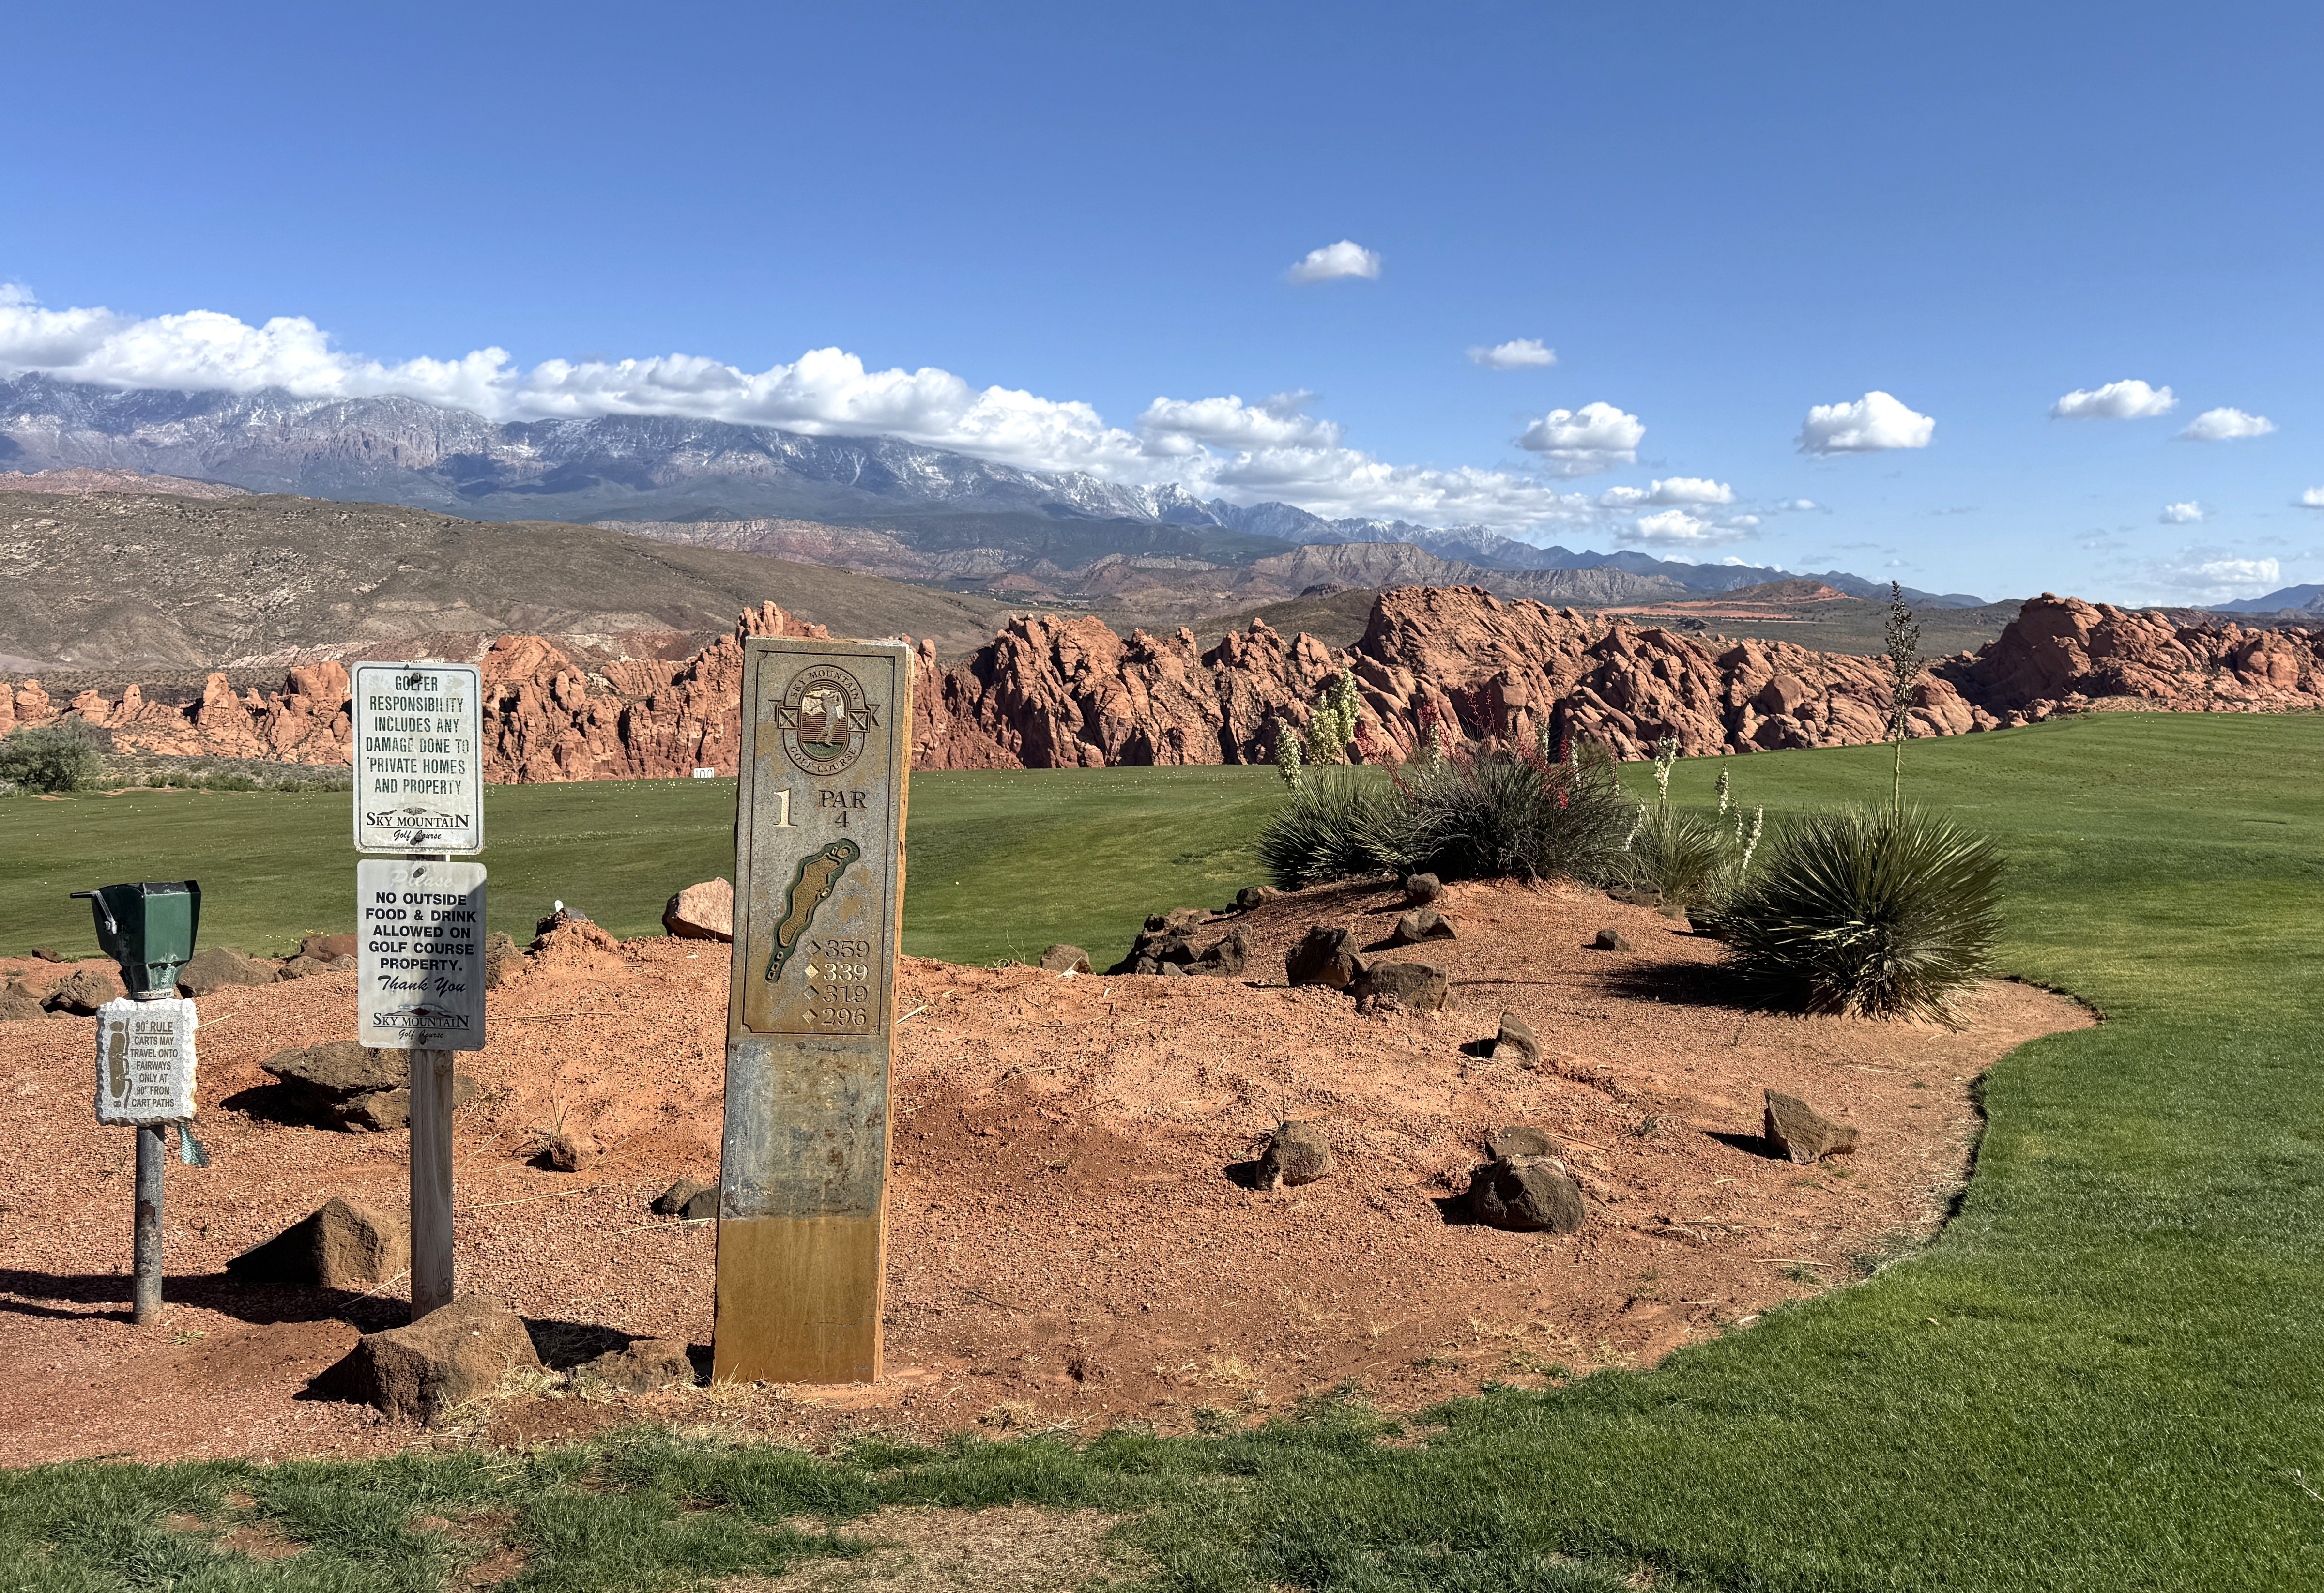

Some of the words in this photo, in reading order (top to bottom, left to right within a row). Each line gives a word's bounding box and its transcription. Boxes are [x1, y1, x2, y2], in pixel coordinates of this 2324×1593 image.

[396, 676, 438, 691] GOLFER
[791, 676, 808, 699] SKY
[809, 670, 861, 701] MOUNTAIN
[370, 696, 463, 713] RESPONSIBILITY
[375, 716, 430, 732] INCLUDES
[437, 718, 459, 733] ANY
[366, 737, 413, 752] DAMAGE
[420, 738, 450, 753] DONE
[455, 739, 469, 754] TO
[370, 757, 417, 773] PRIVATE
[423, 759, 465, 774] HOMES
[790, 746, 814, 769] GOLF
[817, 748, 856, 772] COURSE
[375, 778, 397, 793] AND
[403, 779, 461, 795] PROPERTY
[818, 790, 867, 808] PAR
[774, 788, 798, 827] 1
[366, 812, 393, 826] SKY
[397, 814, 470, 827] MOUNTAIN
[835, 811, 849, 827] 4
[393, 829, 411, 841] Golf
[376, 892, 396, 904] NO
[403, 893, 466, 905] OUTSIDE
[366, 908, 406, 920] FOOD
[414, 910, 423, 920] &
[431, 910, 476, 922] DRINK
[373, 925, 443, 938] ALLOWED
[449, 927, 470, 939] ON
[369, 941, 407, 953] GOLF
[413, 942, 474, 955] COURSE
[824, 939, 870, 958] 359
[380, 957, 462, 971] PROPERTY.
[823, 963, 869, 981] 339
[377, 975, 428, 991] Thank
[434, 977, 466, 997] You
[822, 985, 868, 1003] 319
[373, 1012, 397, 1025] SKY
[402, 1015, 469, 1027] MOUNTAIN
[822, 1008, 867, 1026] 296
[150, 1022, 173, 1032] RULE
[398, 1029, 415, 1040] Golf
[135, 1037, 158, 1045] CARTS
[160, 1037, 174, 1045] MAY
[131, 1049, 156, 1057] TRAVEL
[159, 1049, 178, 1058] ONTO
[137, 1061, 171, 1070] FAIRWAYS
[139, 1073, 157, 1082] ONLY
[159, 1073, 168, 1082] AT
[150, 1086, 170, 1095] FROM
[132, 1099, 151, 1107] CART
[153, 1099, 174, 1107] PATHS
